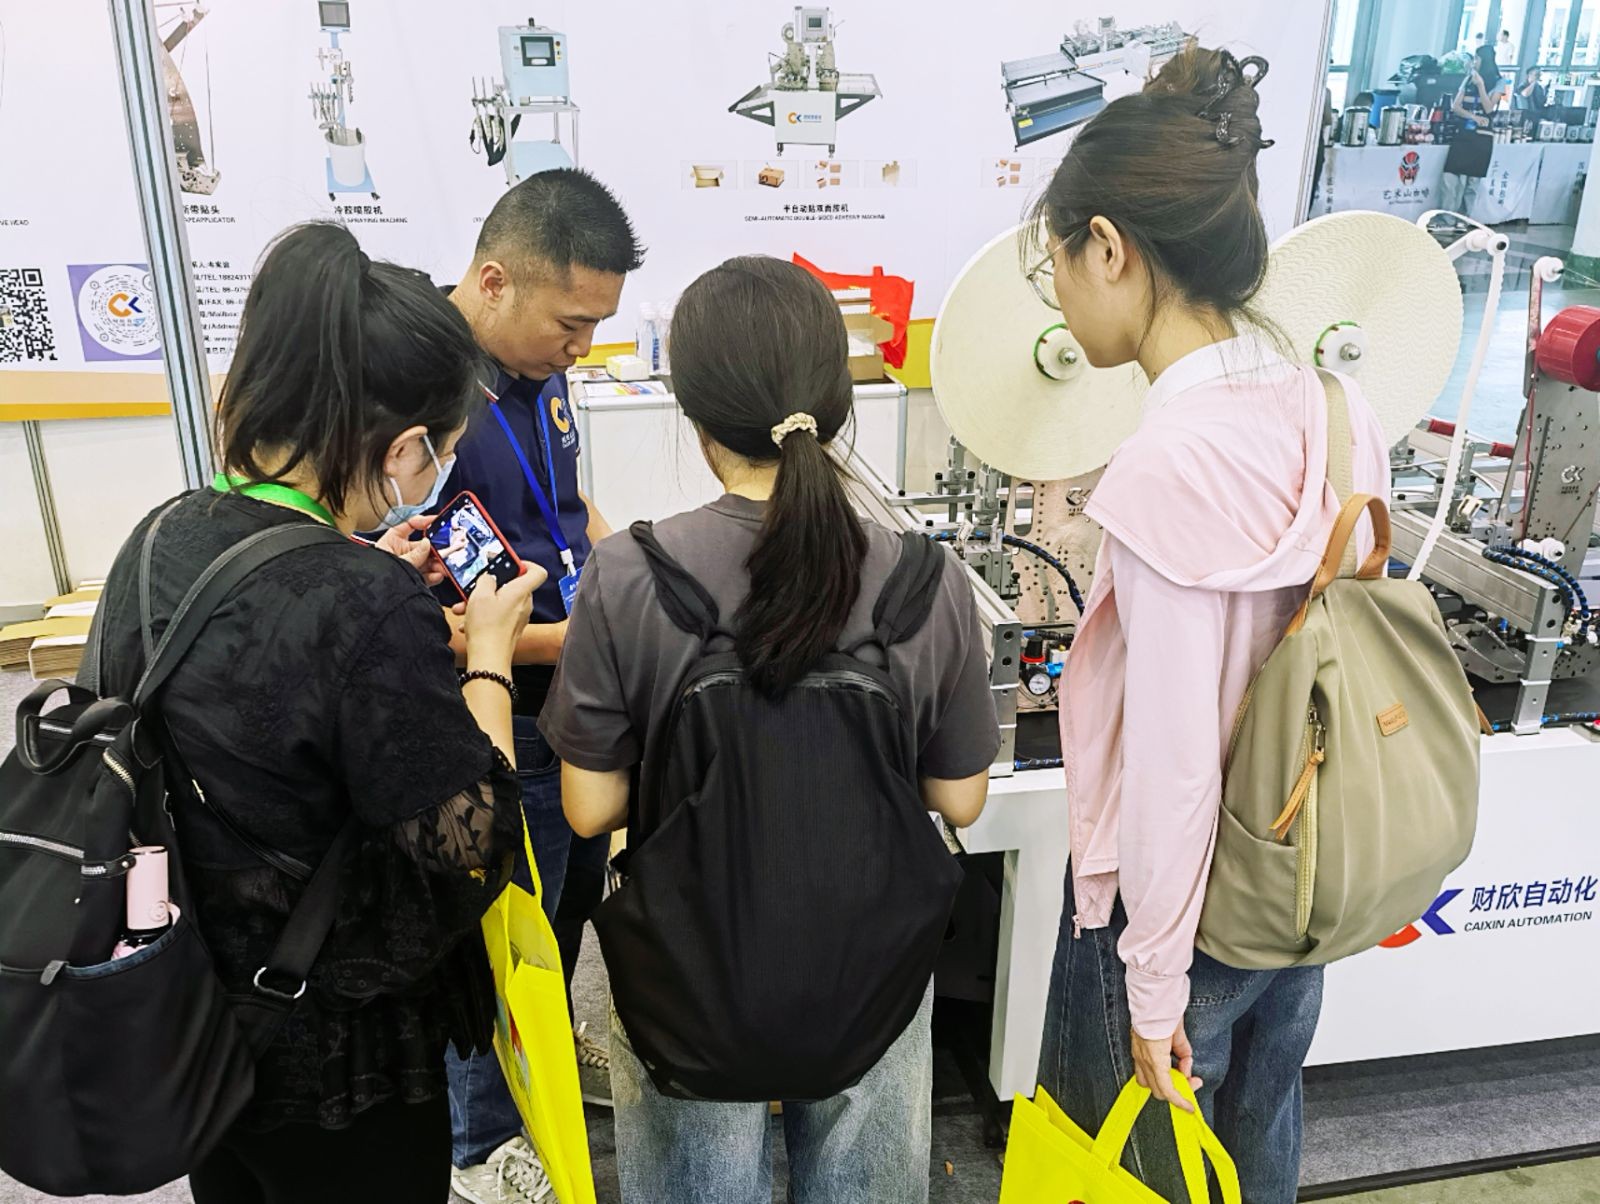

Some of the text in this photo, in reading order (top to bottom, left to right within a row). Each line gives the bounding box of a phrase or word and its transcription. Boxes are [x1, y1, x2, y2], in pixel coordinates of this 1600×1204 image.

[1469, 875, 1598, 913] 财欣自动化
[1464, 911, 1593, 932] CAIXIN AUTOMATION
